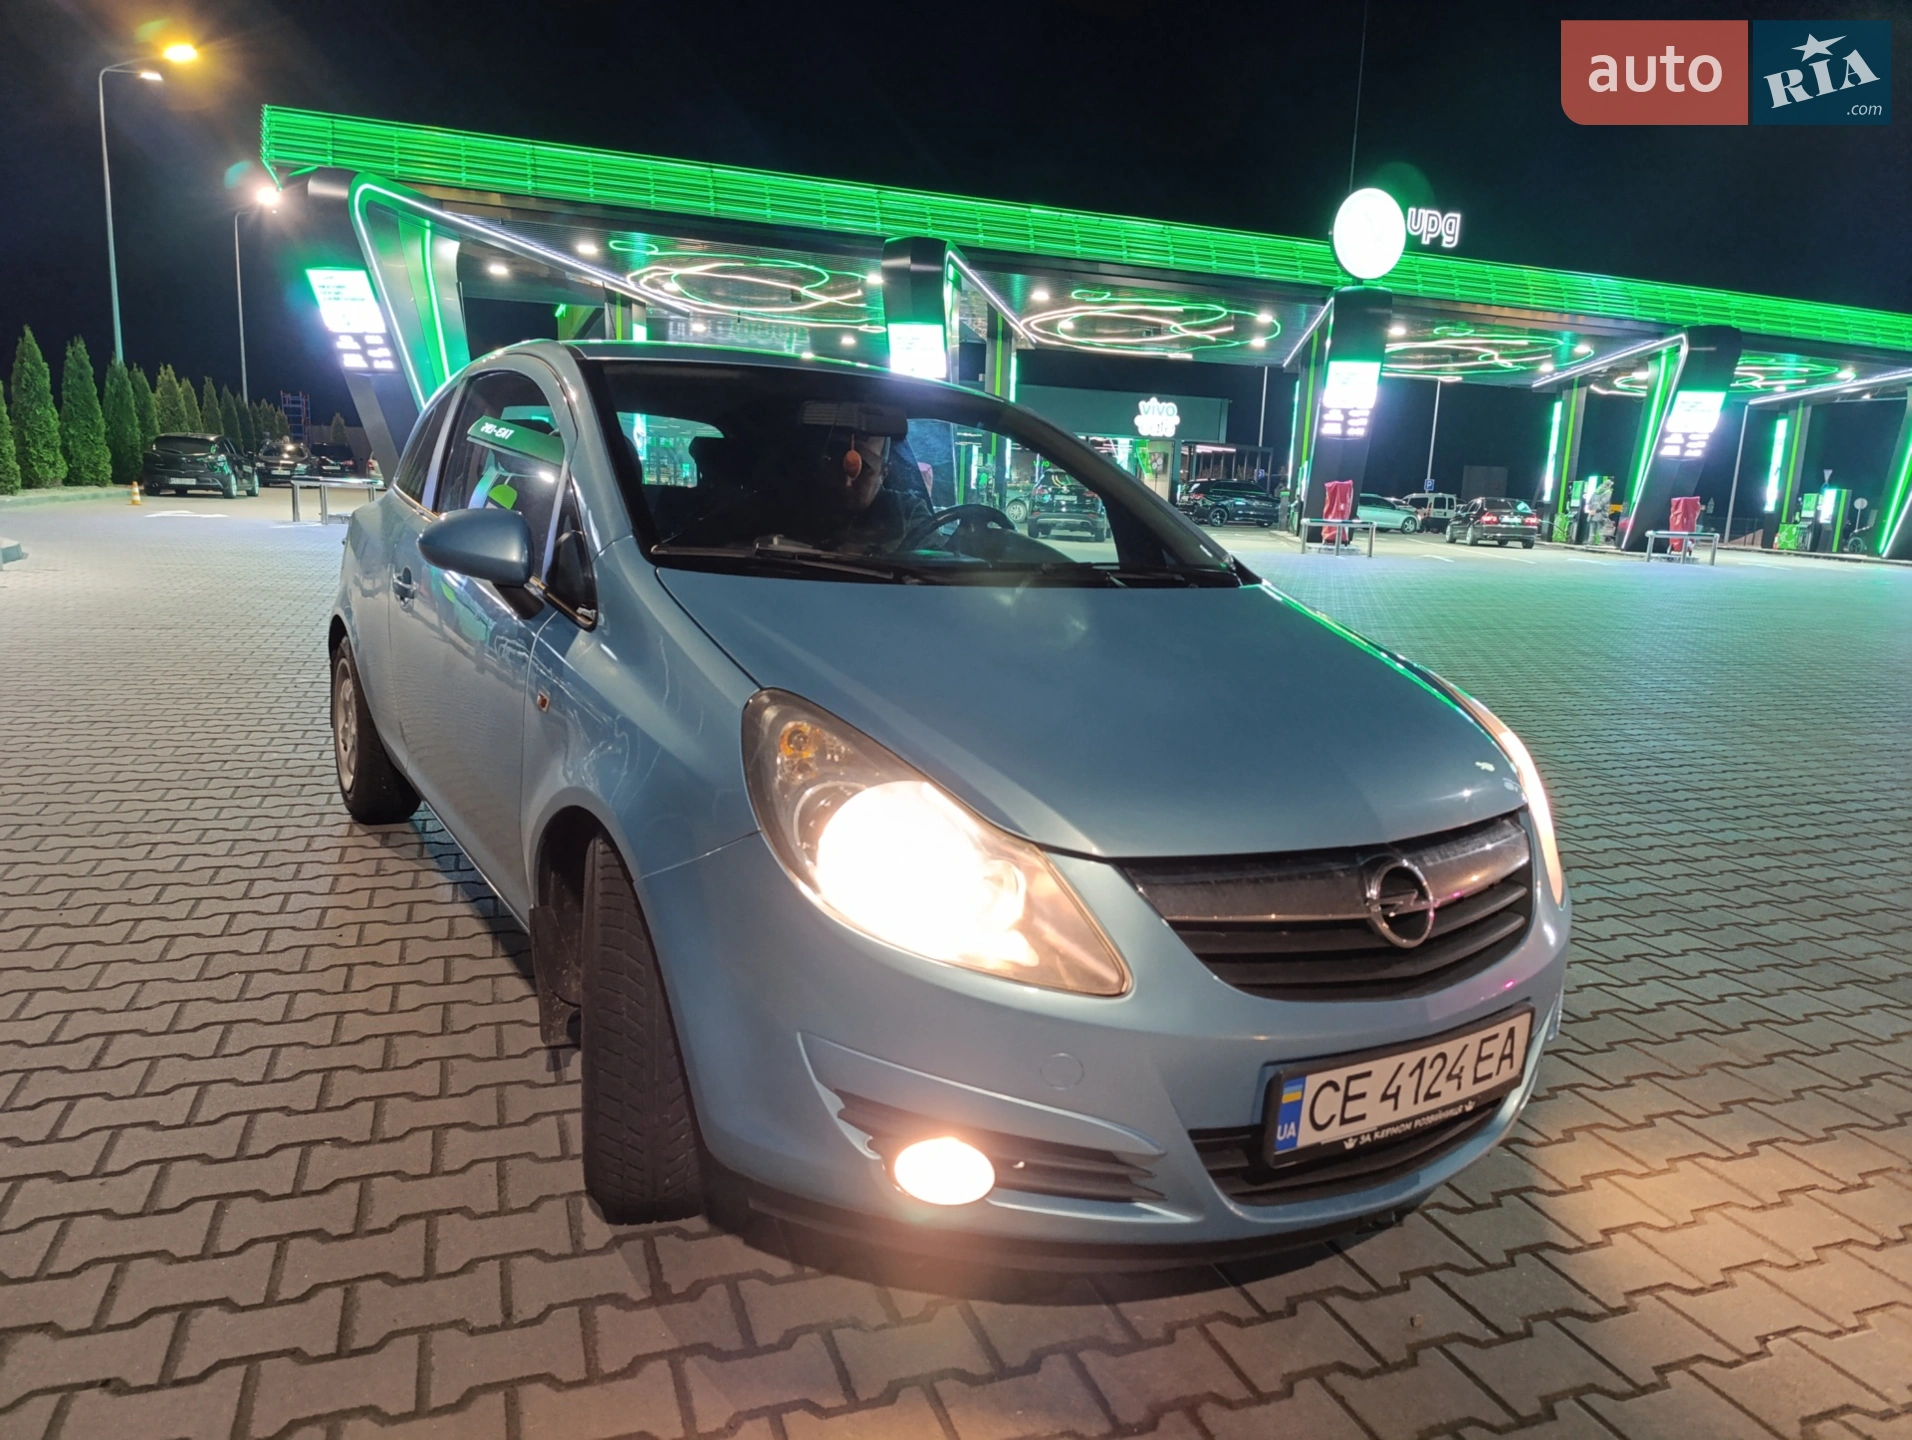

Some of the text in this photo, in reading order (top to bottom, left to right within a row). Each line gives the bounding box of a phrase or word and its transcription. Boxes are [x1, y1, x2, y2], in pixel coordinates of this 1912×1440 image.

[1407, 207, 1461, 248] upg
[1309, 1026, 1516, 1132] CE 4124 EA
[1276, 1121, 1297, 1141] UA
[1358, 1132, 1372, 1145] ЗА
